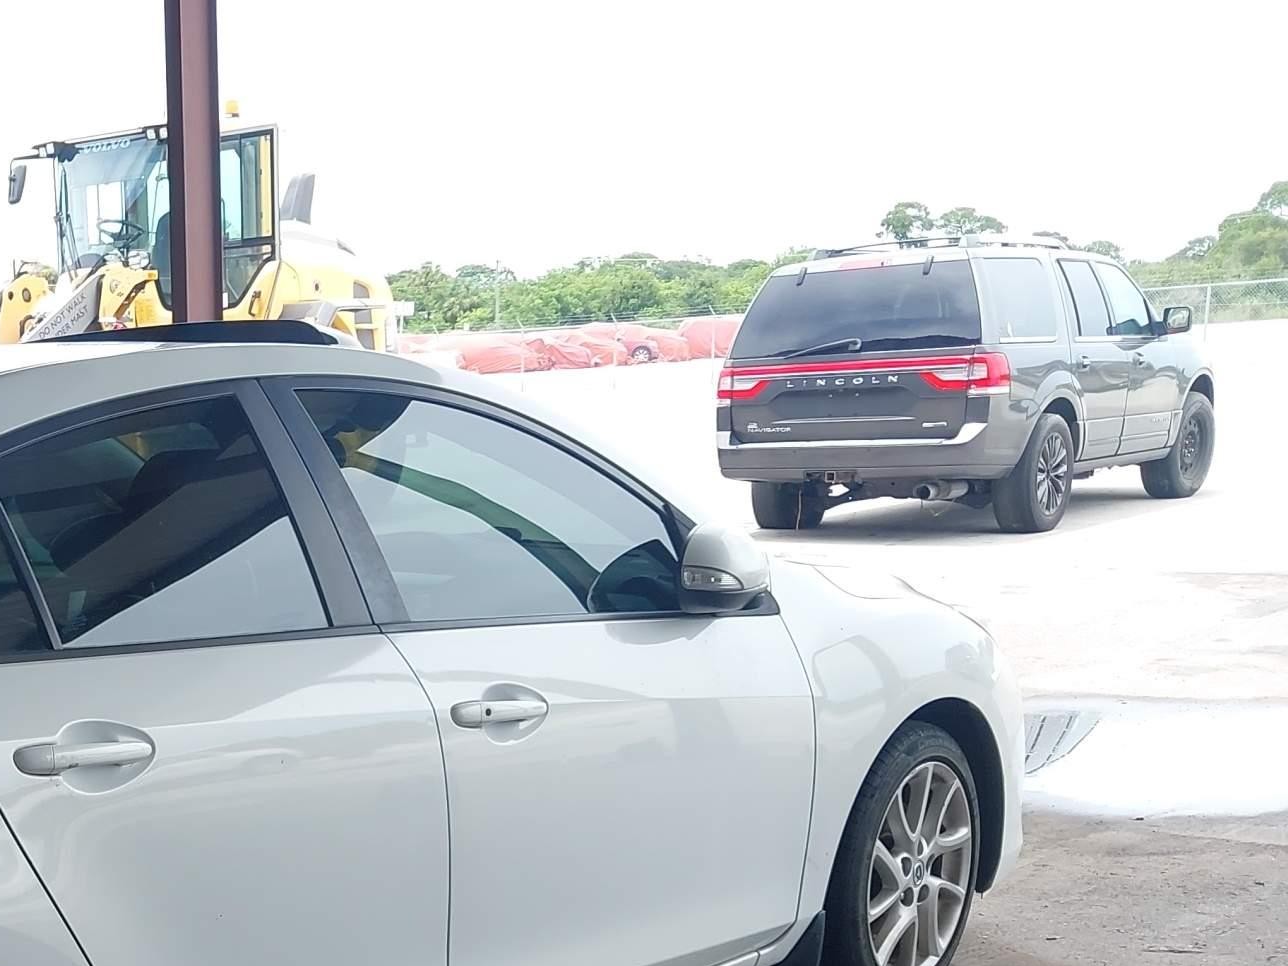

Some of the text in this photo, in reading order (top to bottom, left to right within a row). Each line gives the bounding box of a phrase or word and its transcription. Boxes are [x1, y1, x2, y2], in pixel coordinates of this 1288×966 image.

[82, 139, 130, 153] VOLVO
[39, 292, 87, 339] DO NOT WALK
[71, 304, 89, 325] MAST
[786, 375, 899, 388] LINCOLN
